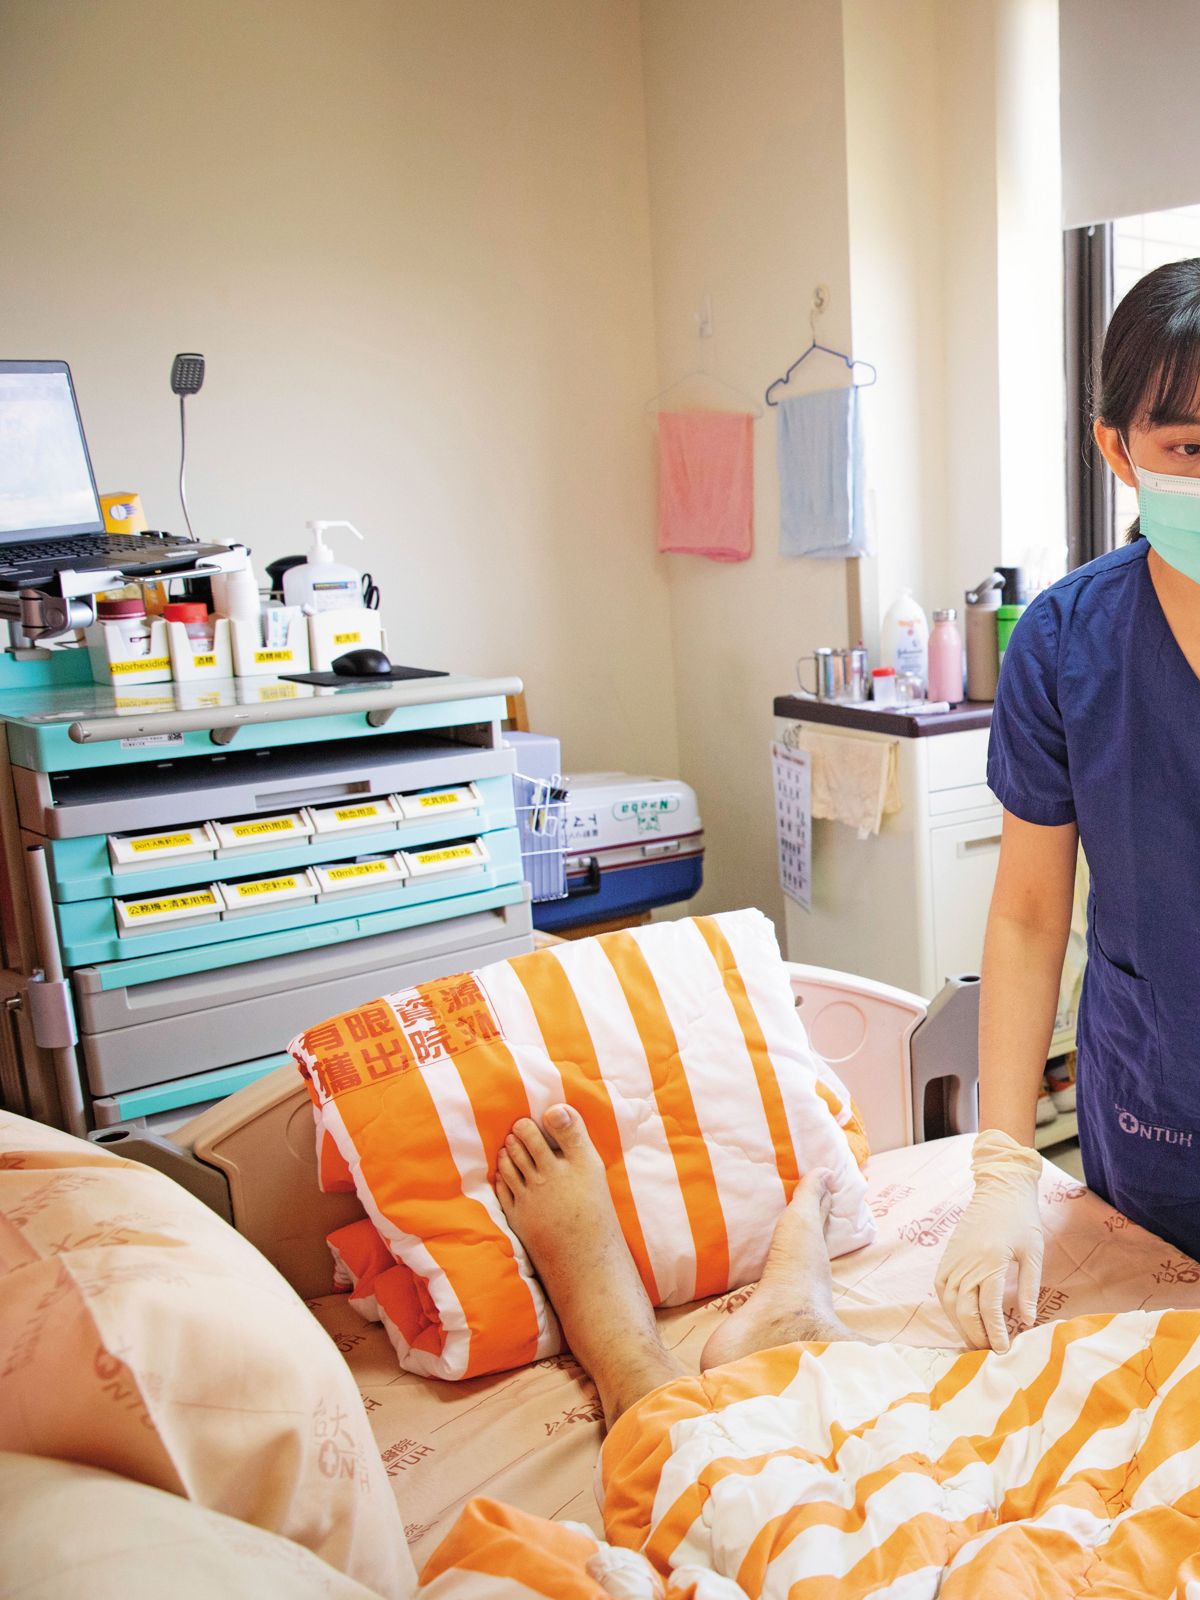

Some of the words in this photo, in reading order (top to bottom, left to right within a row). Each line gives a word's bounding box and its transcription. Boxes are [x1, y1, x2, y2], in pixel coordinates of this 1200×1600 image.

[110, 657, 170, 674] chlorhexidine
[236, 827, 250, 837] on
[240, 884, 260, 896] 5ml
[1140, 1125, 1193, 1148] NTUH
